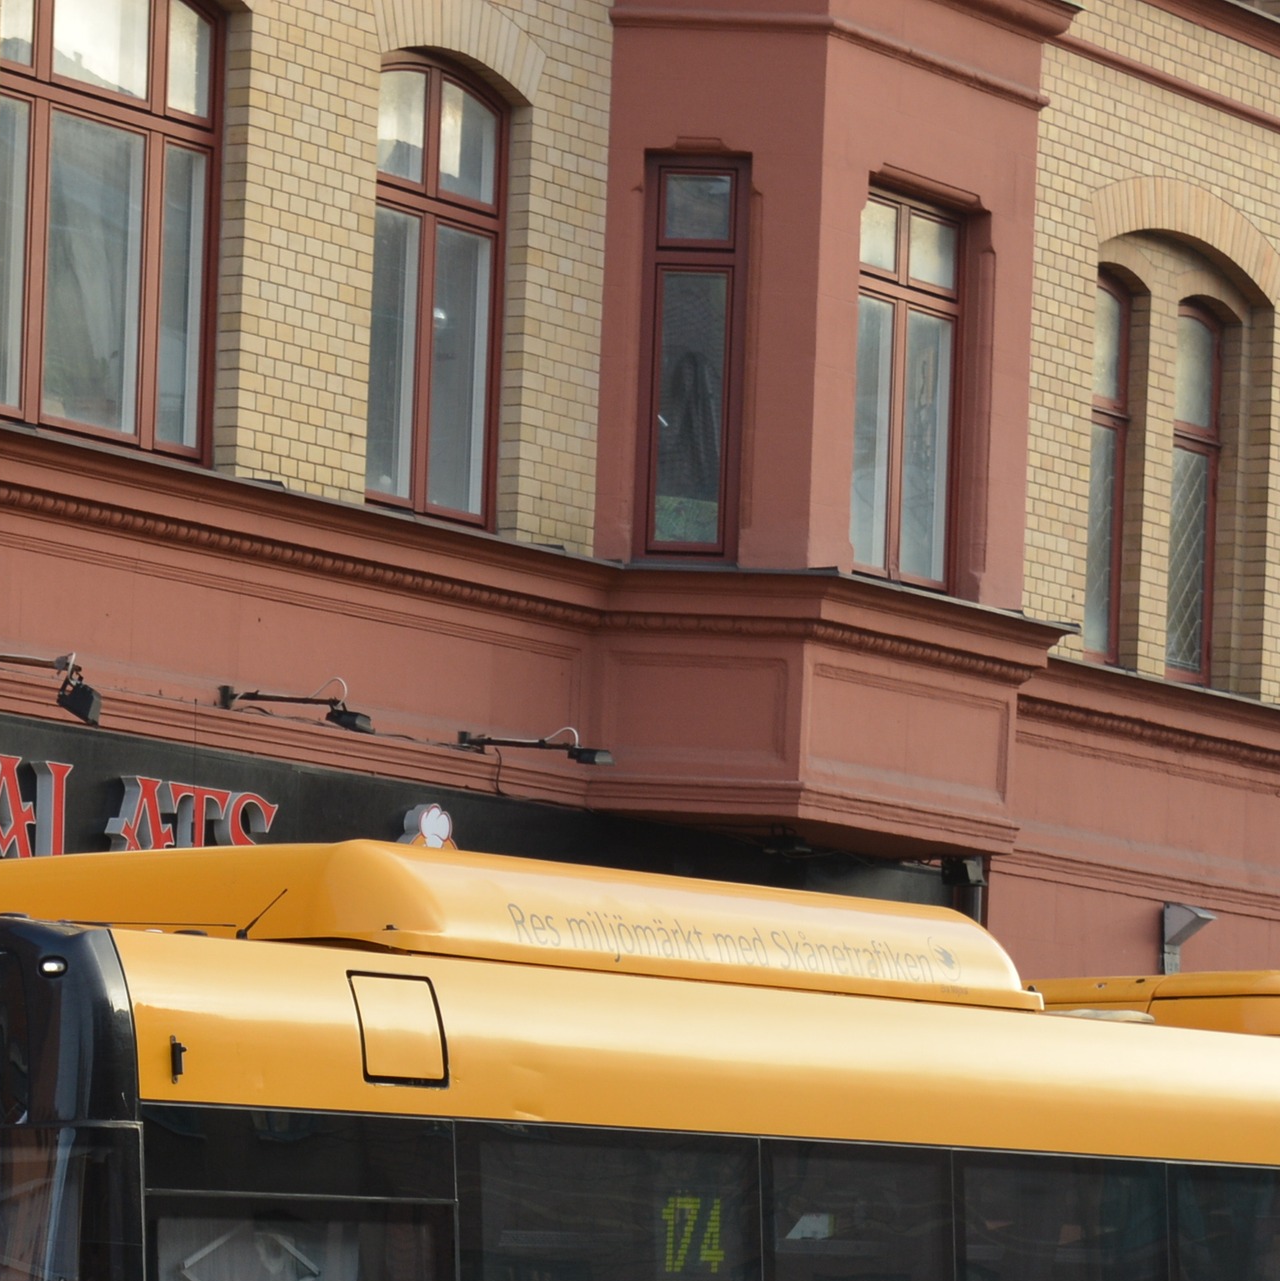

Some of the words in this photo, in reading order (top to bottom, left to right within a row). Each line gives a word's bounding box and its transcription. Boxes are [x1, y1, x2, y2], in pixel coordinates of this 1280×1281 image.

[507, 903, 563, 947] Res
[566, 909, 711, 962] miljömärkt
[712, 926, 770, 967] med
[770, 930, 934, 984] Skånetrafiken
[662, 1197, 725, 1273] 174
